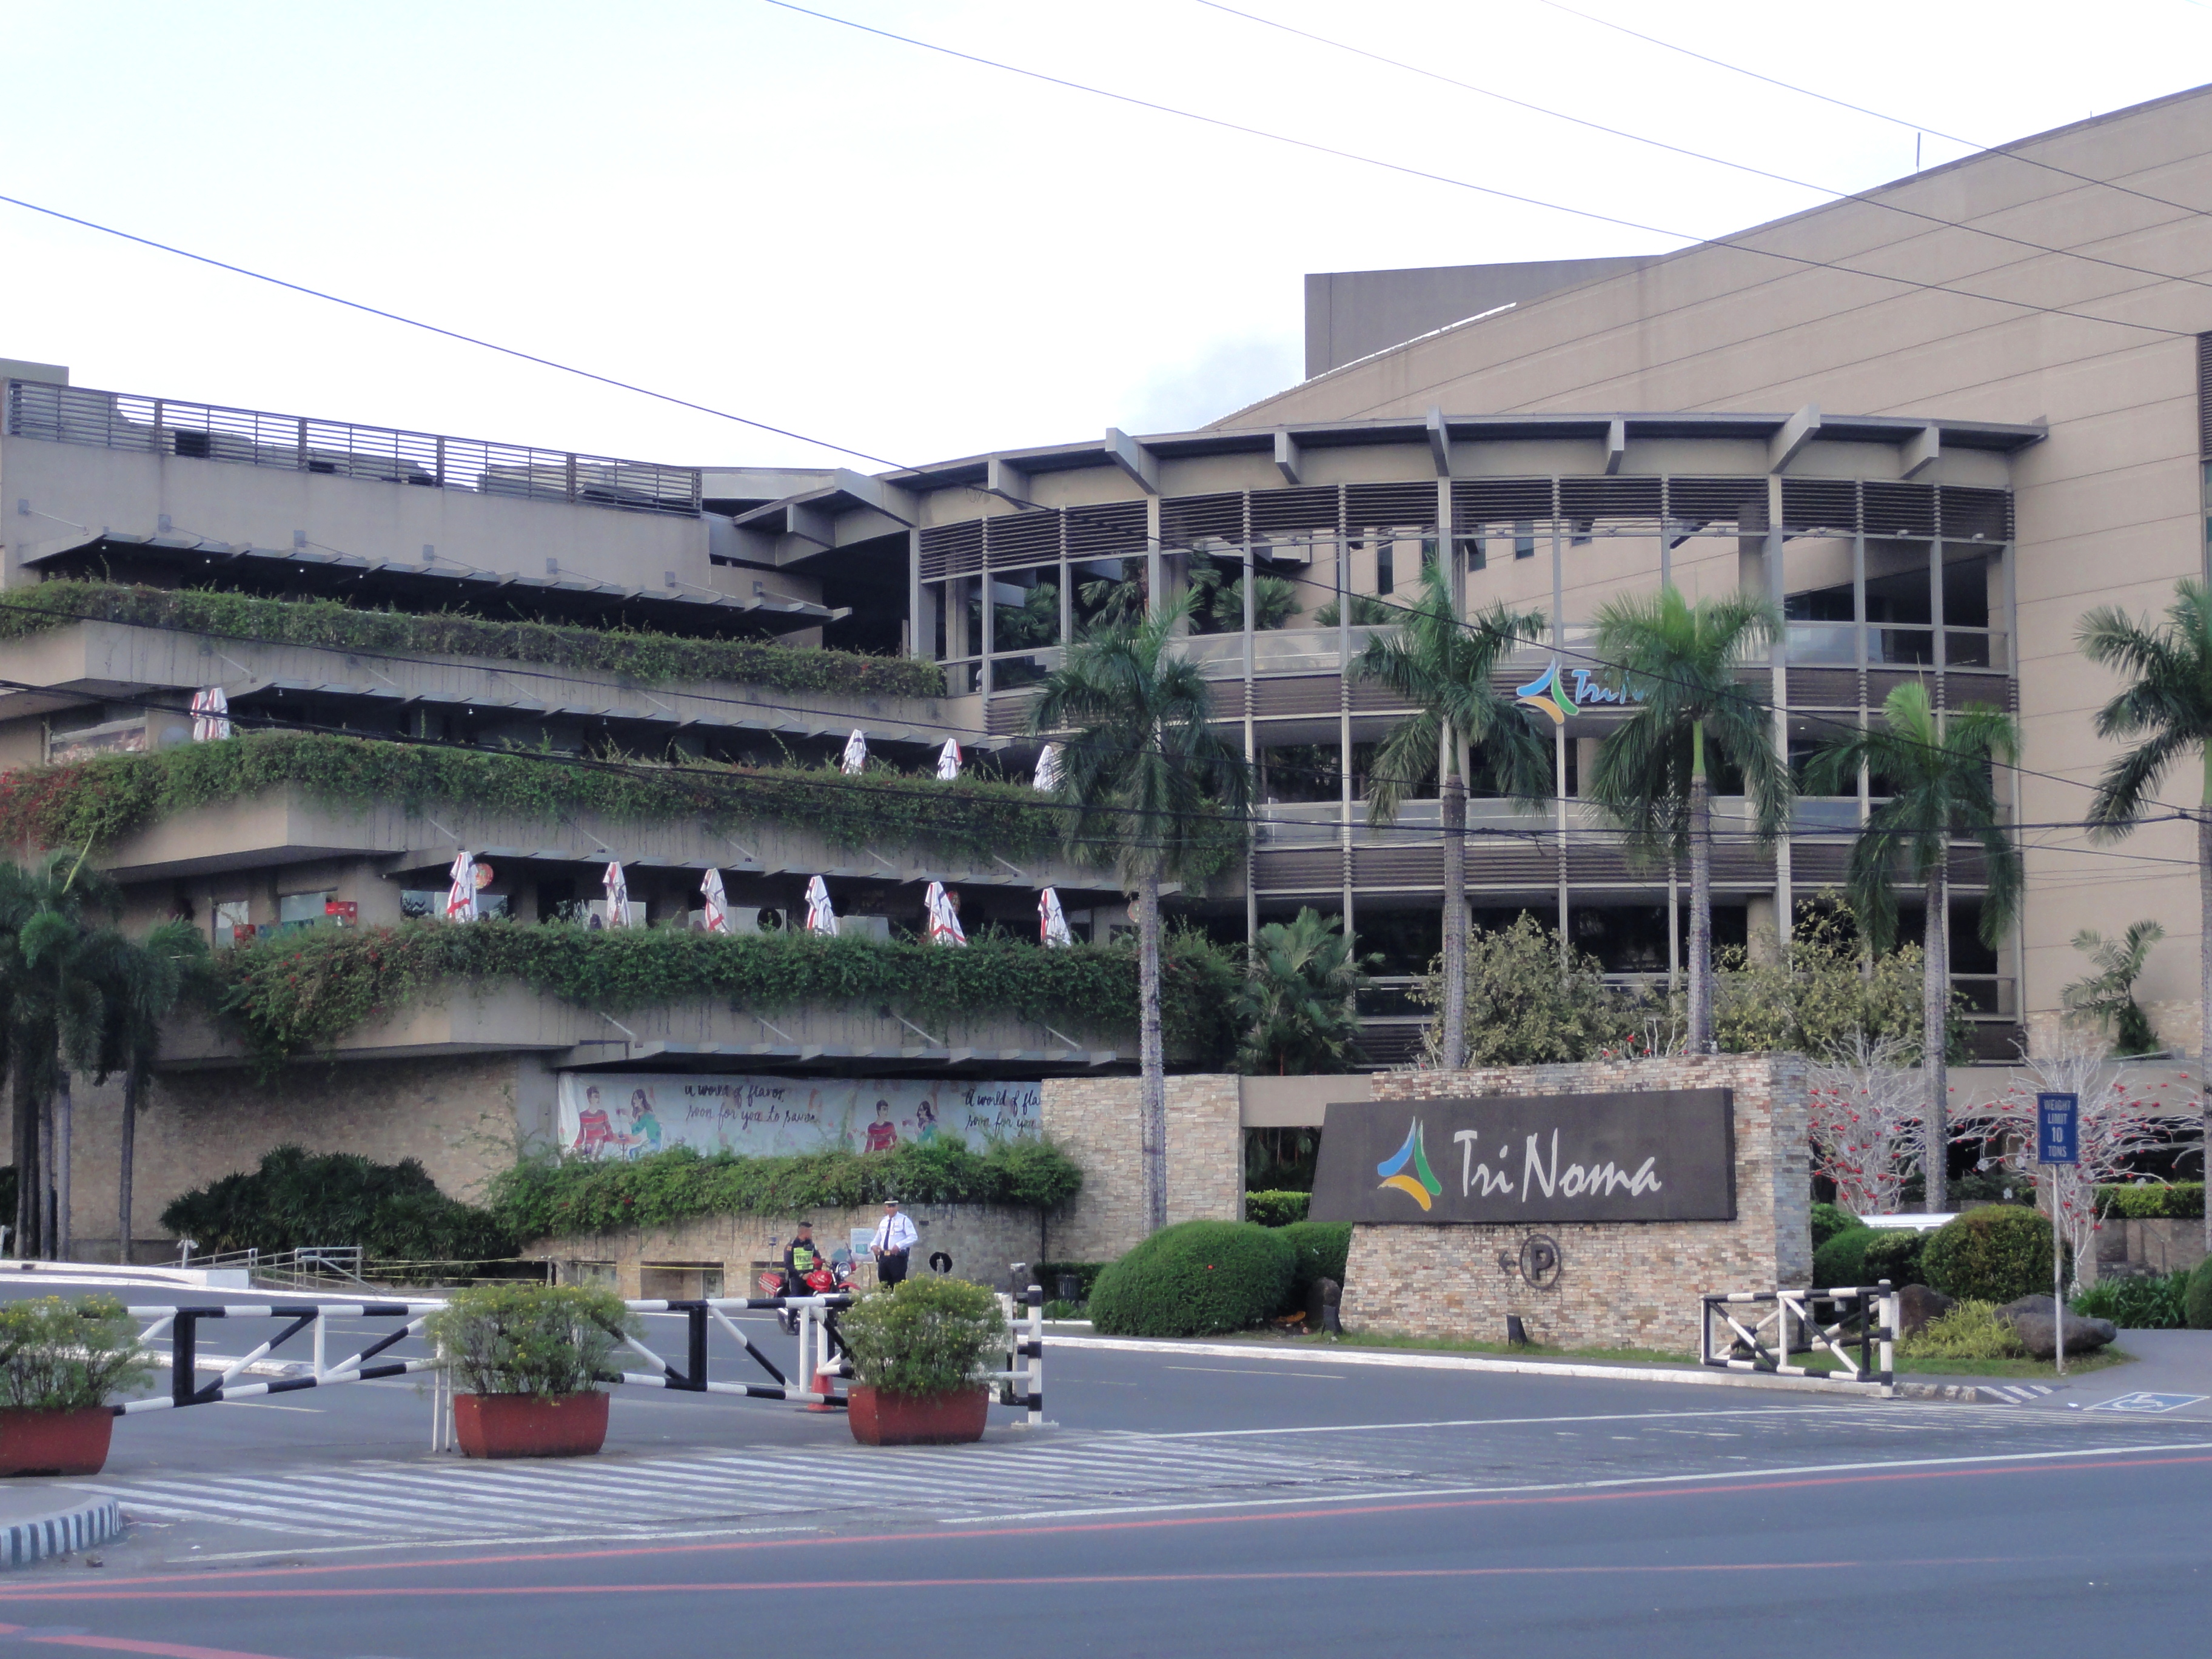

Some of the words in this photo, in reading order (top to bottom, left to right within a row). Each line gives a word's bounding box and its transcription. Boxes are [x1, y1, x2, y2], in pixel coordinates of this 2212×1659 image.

[977, 1090, 1007, 1107] world
[1010, 1090, 1020, 1118] of
[2043, 1099, 2071, 1111] WEIGHT
[686, 1104, 713, 1121] soon
[717, 1102, 737, 1131] for
[741, 1111, 762, 1130] you
[766, 1105, 780, 1122] to
[2048, 1113, 2068, 1125] LIMIT
[2052, 1126, 2064, 1143] 10
[2048, 1145, 2067, 1158] TONS
[1530, 1243, 1555, 1280] P
